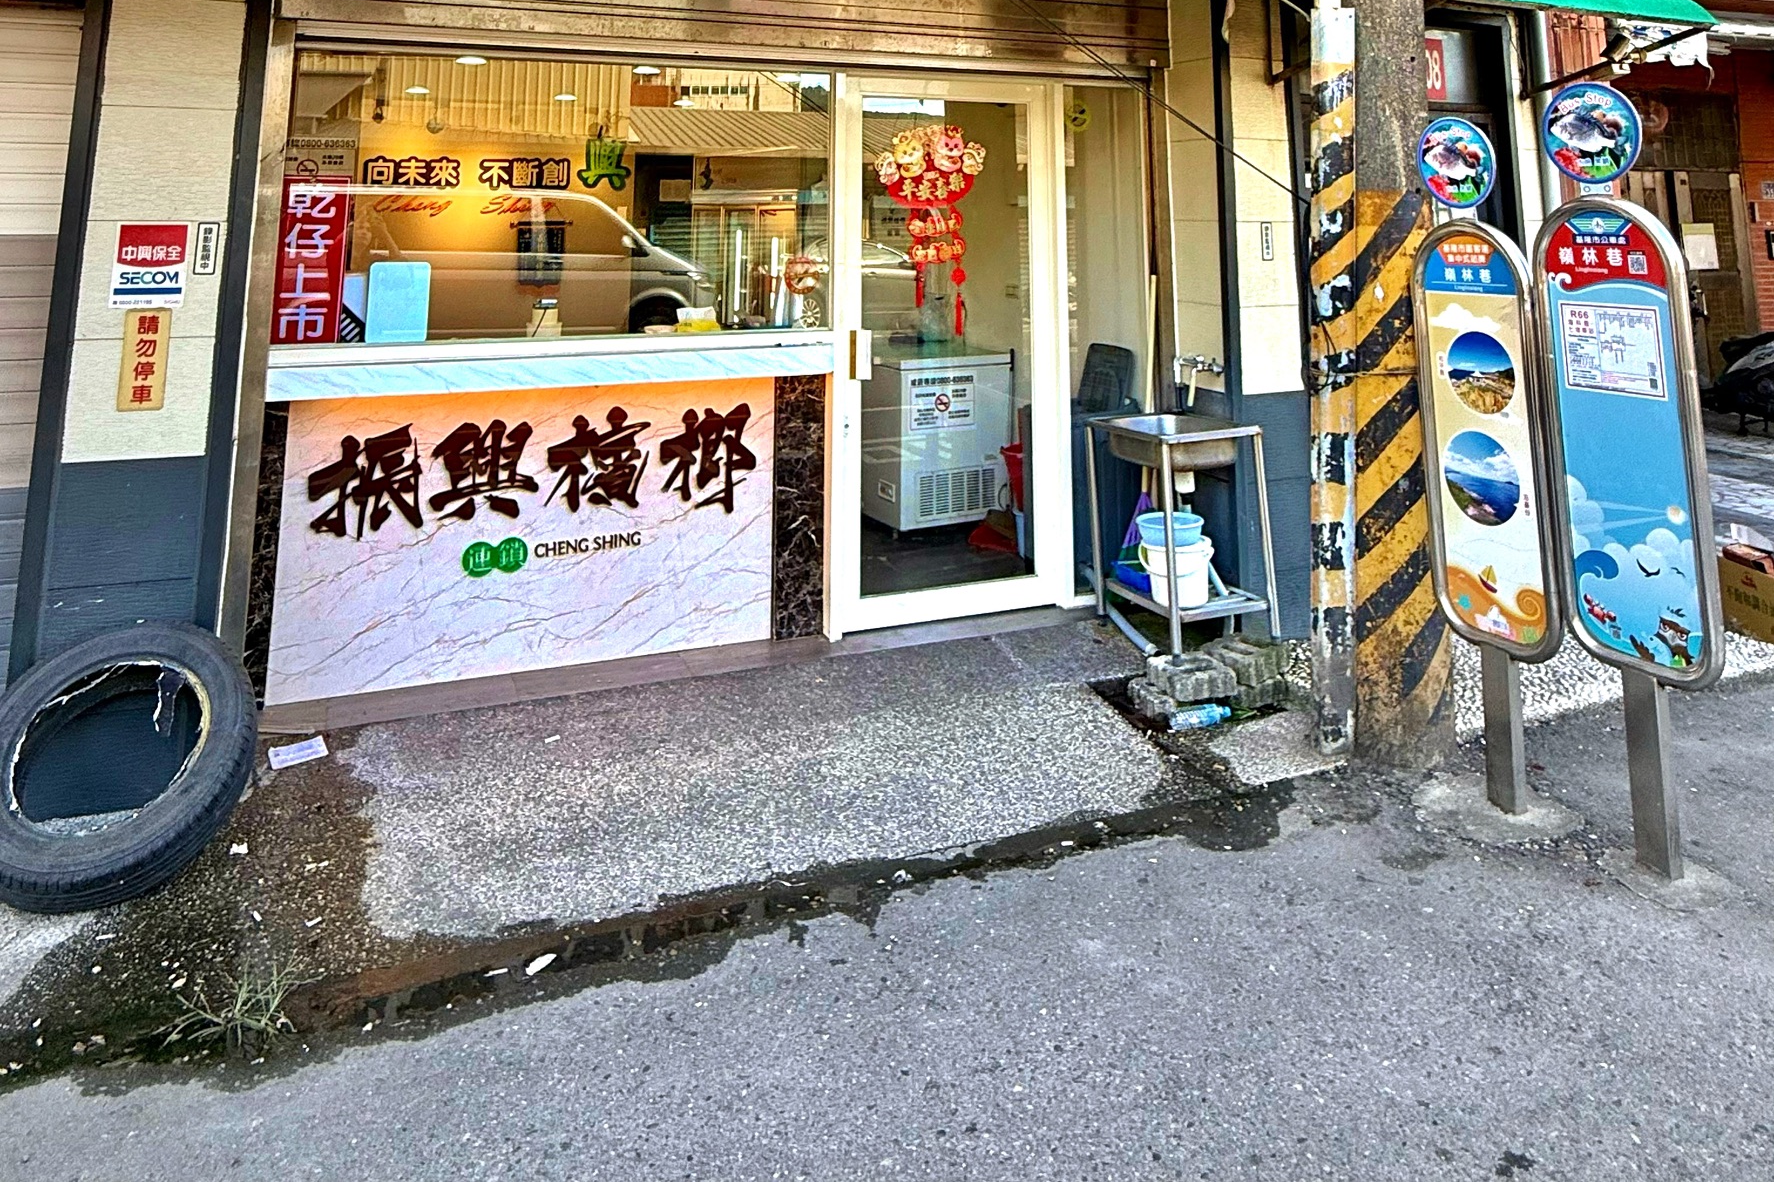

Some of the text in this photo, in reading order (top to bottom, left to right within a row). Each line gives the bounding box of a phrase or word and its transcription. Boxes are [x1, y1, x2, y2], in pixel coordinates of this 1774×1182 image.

[1560, 93, 1612, 113] Bus Stop
[366, 159, 458, 187] 向未來
[481, 161, 569, 187] 不斷創
[121, 245, 182, 261] 中興保全
[119, 271, 179, 285] SECOM
[1570, 310, 1589, 319] R66
[129, 314, 160, 405] 請勿停車
[307, 402, 758, 540] 振興檳榔
[469, 541, 526, 572] 連鎖
[534, 531, 642, 558] CHENG SHING
